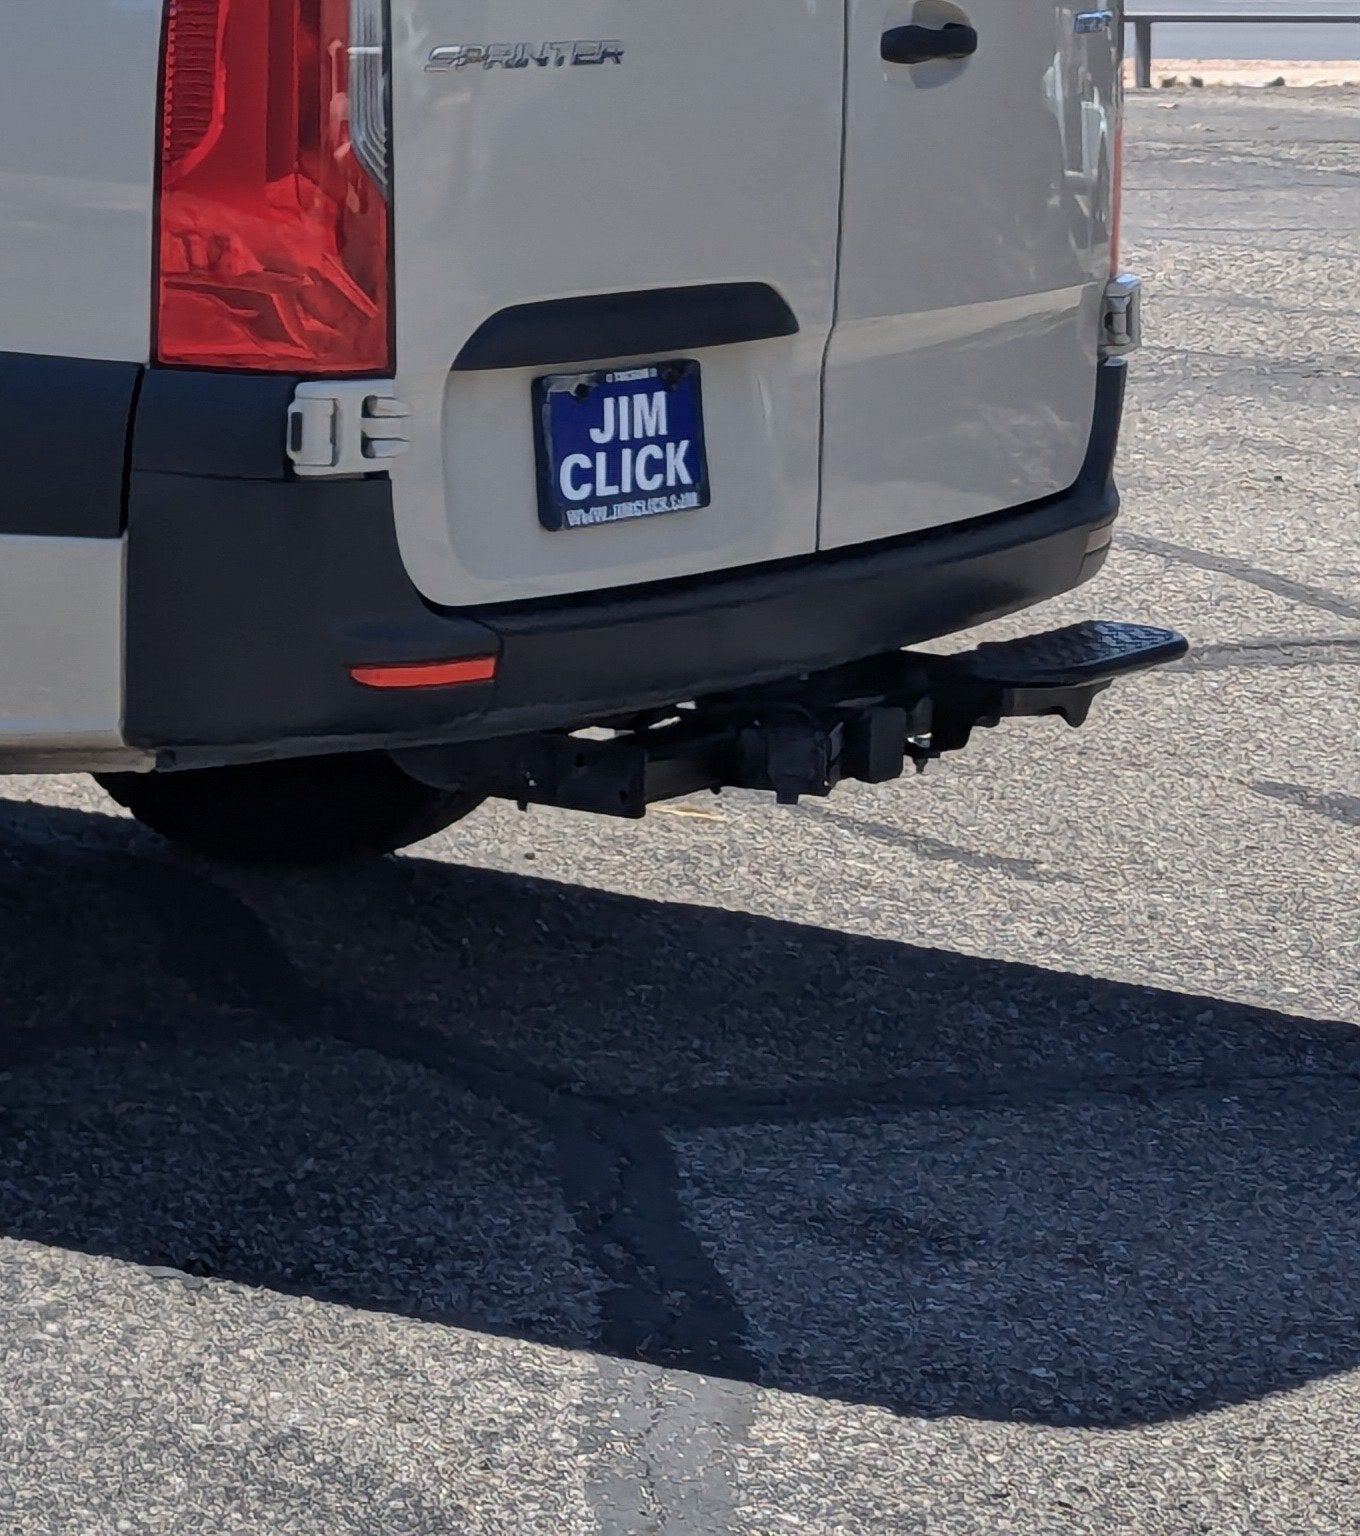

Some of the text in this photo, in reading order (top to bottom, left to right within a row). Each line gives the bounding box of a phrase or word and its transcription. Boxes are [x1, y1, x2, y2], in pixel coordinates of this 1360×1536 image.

[424, 40, 624, 72] SPRINTER
[589, 390, 668, 444] JIM
[559, 439, 693, 501] CLICK
